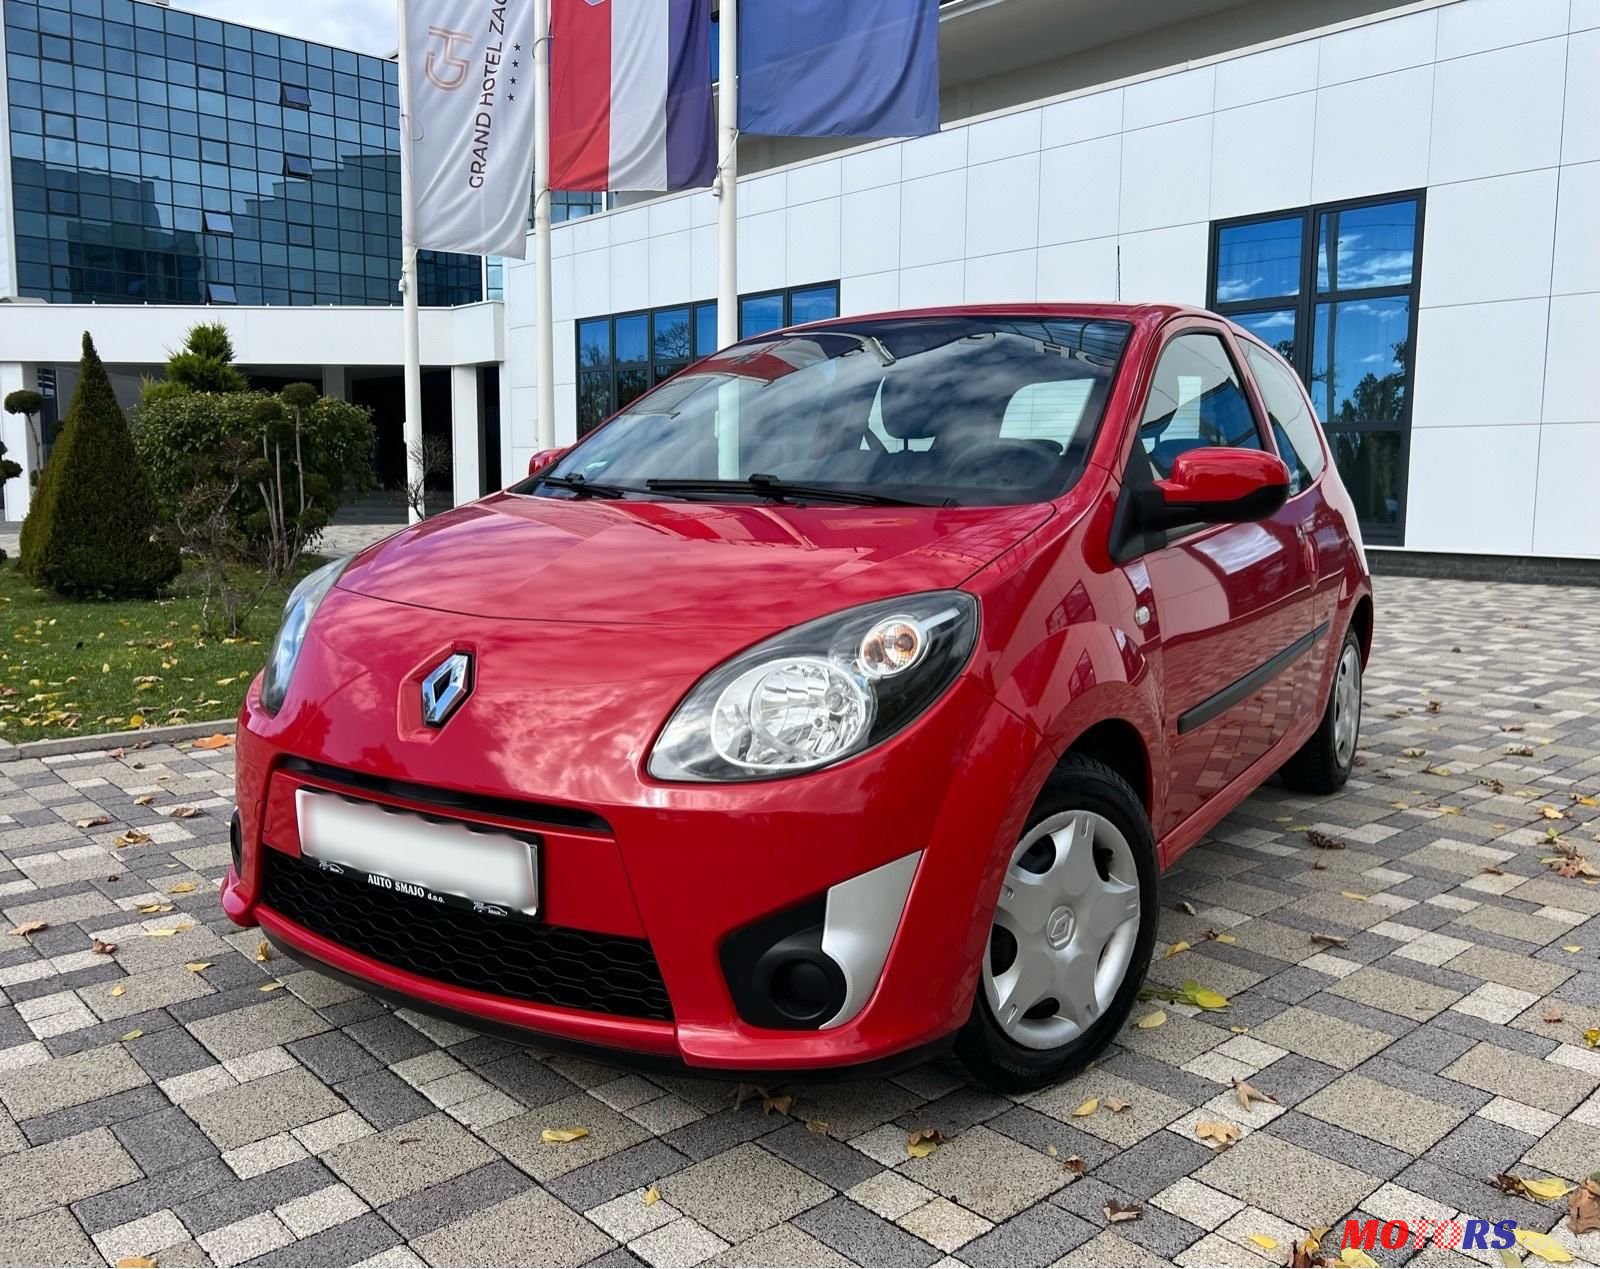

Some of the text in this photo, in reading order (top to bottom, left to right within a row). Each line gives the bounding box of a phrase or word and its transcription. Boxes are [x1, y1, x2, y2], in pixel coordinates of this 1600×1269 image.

[479, 42, 502, 106] HOTEL
[469, 112, 492, 189] GRAND
[367, 873, 445, 904] AUTO SMAJO d.o.o.
